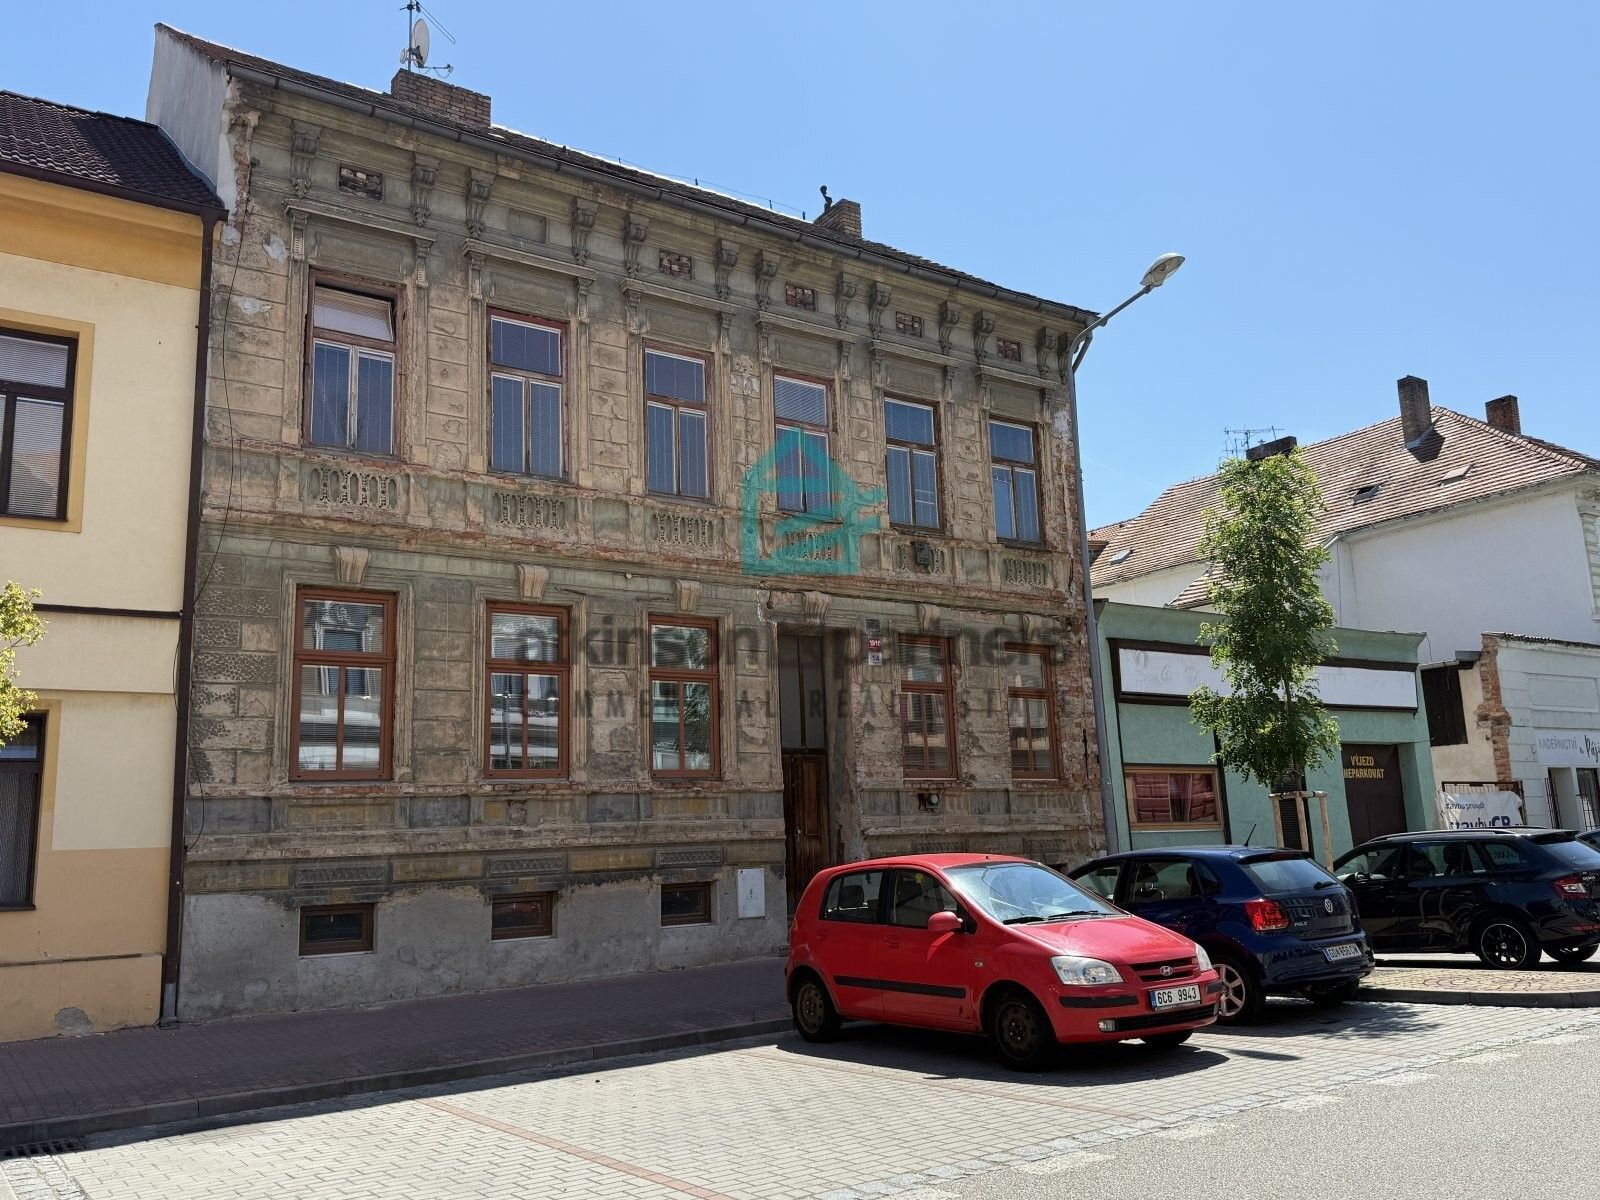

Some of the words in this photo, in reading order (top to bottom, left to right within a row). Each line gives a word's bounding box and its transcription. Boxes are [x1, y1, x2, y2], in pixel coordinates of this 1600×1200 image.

[1350, 753, 1375, 766] VÝJEZD
[1343, 768, 1384, 779] NEPARKOVAT
[1157, 990, 1173, 1004] 6C6
[1177, 987, 1197, 1001] 9943
